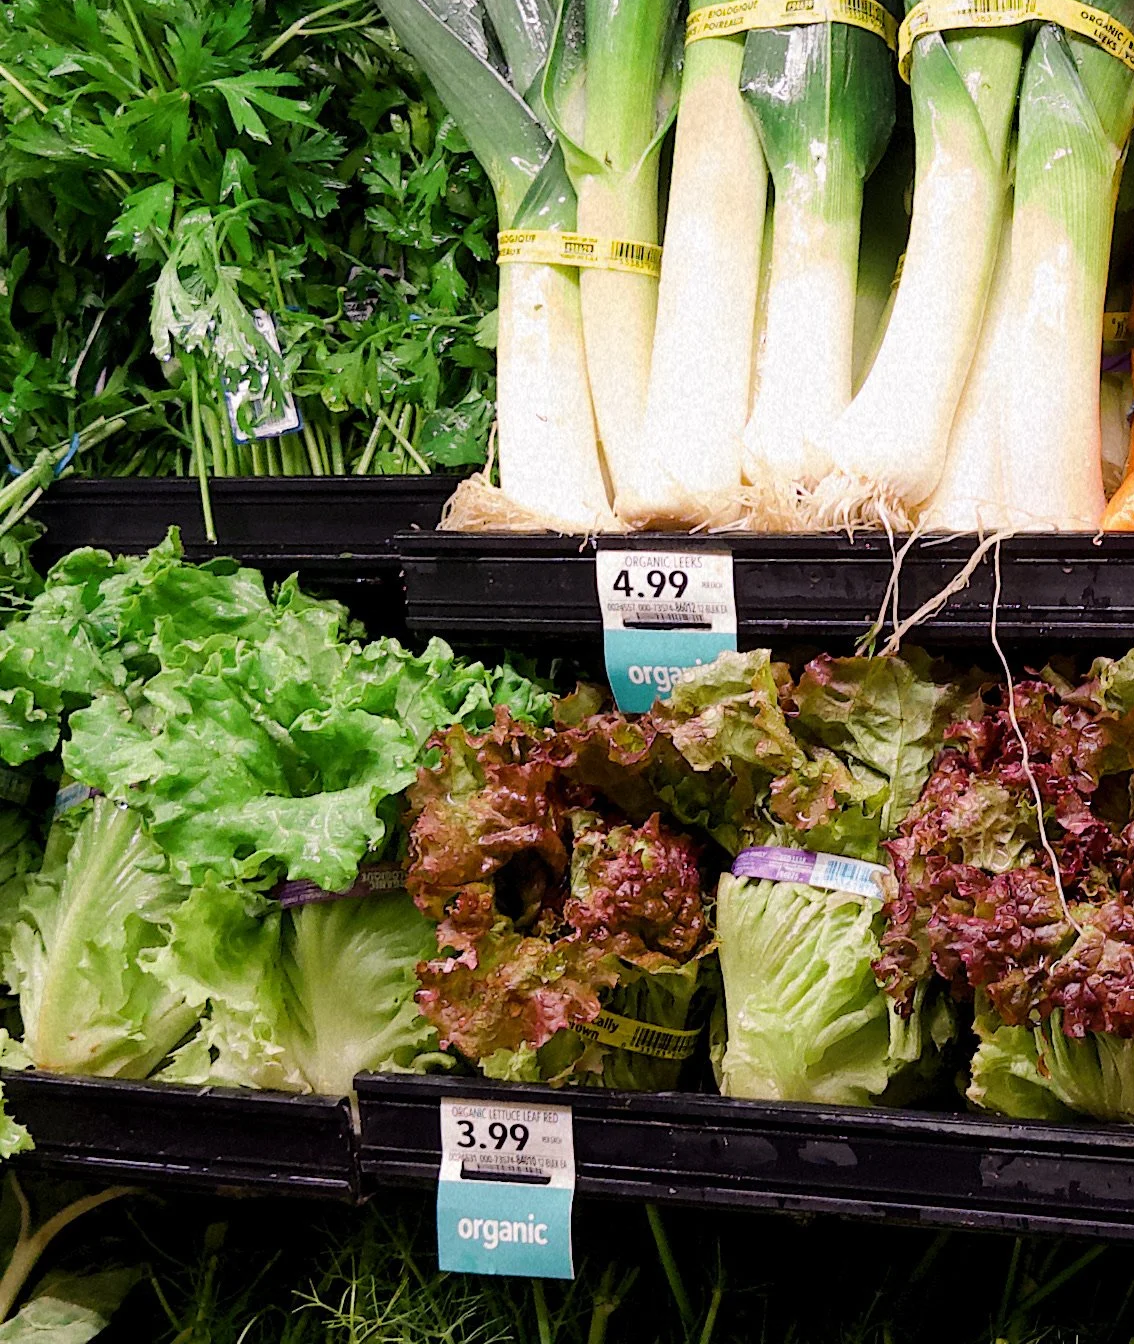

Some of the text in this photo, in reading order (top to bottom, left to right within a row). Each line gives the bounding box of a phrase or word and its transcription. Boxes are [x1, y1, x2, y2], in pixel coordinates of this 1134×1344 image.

[708, 0, 758, 18] BIOLOGIQUE
[703, 17, 744, 31] POIREAUX
[1081, 11, 1123, 41] ORGANIC
[1094, 29, 1117, 50] LEEKS
[625, 556, 703, 568] ORGANIC LEEKS
[613, 570, 688, 598] 4.99
[568, 1020, 599, 1040] rown
[452, 1107, 558, 1124] ORGANIC LETTUCE LEAF RED
[456, 1120, 529, 1151] 3.99
[458, 1213, 548, 1249] organic
